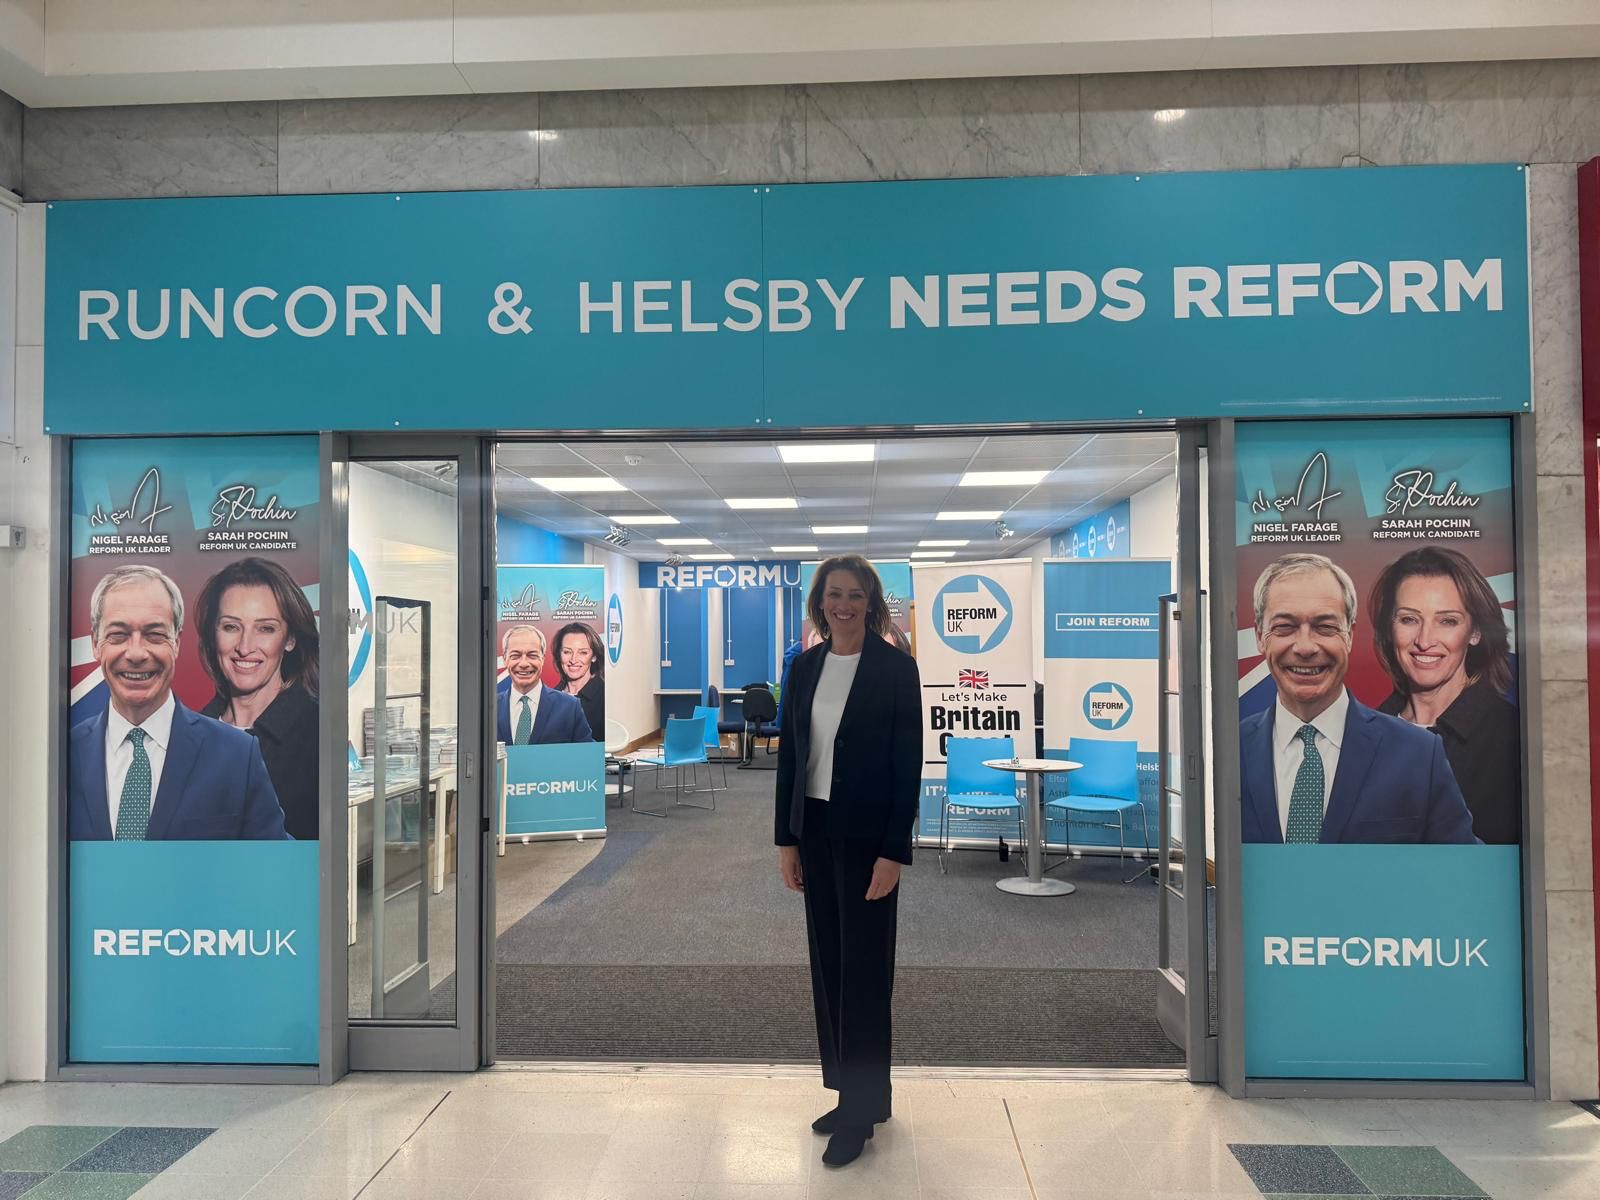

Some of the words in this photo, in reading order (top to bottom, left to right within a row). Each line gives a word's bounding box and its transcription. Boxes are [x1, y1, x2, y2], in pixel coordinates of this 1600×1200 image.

[78, 282, 442, 341] RUNCORN
[487, 281, 533, 335] &
[578, 276, 865, 334] HELSBY
[889, 267, 1147, 330] NEEDS
[1173, 257, 1504, 320] REFORM
[1253, 523, 1289, 532] NIGEL
[1291, 522, 1338, 532] FARAGE
[1381, 520, 1422, 529] SARAH
[1425, 519, 1471, 528] POCHIN
[207, 532, 245, 541] SARAH
[246, 531, 289, 540] POCHIN
[1250, 534, 1289, 543] REFORM
[1290, 534, 1304, 542] UK
[1305, 534, 1342, 542] LEADER
[1372, 530, 1411, 539] REFORM
[1413, 530, 1426, 538] UK
[1428, 529, 1481, 538] CANDIDATE
[92, 536, 124, 545] NIGEL
[126, 535, 169, 544] FARAGE
[657, 564, 800, 588] REFORMU
[947, 607, 998, 620] REFORM
[947, 620, 963, 633] UK
[1066, 616, 1097, 627] JOIN
[1099, 616, 1150, 627] REFORM
[941, 691, 971, 702] Let's
[973, 691, 1008, 702] Make
[1092, 702, 1124, 710] REFORM
[930, 705, 1021, 731] Britain
[1092, 709, 1102, 717] UK
[1136, 762, 1159, 771] Helsb
